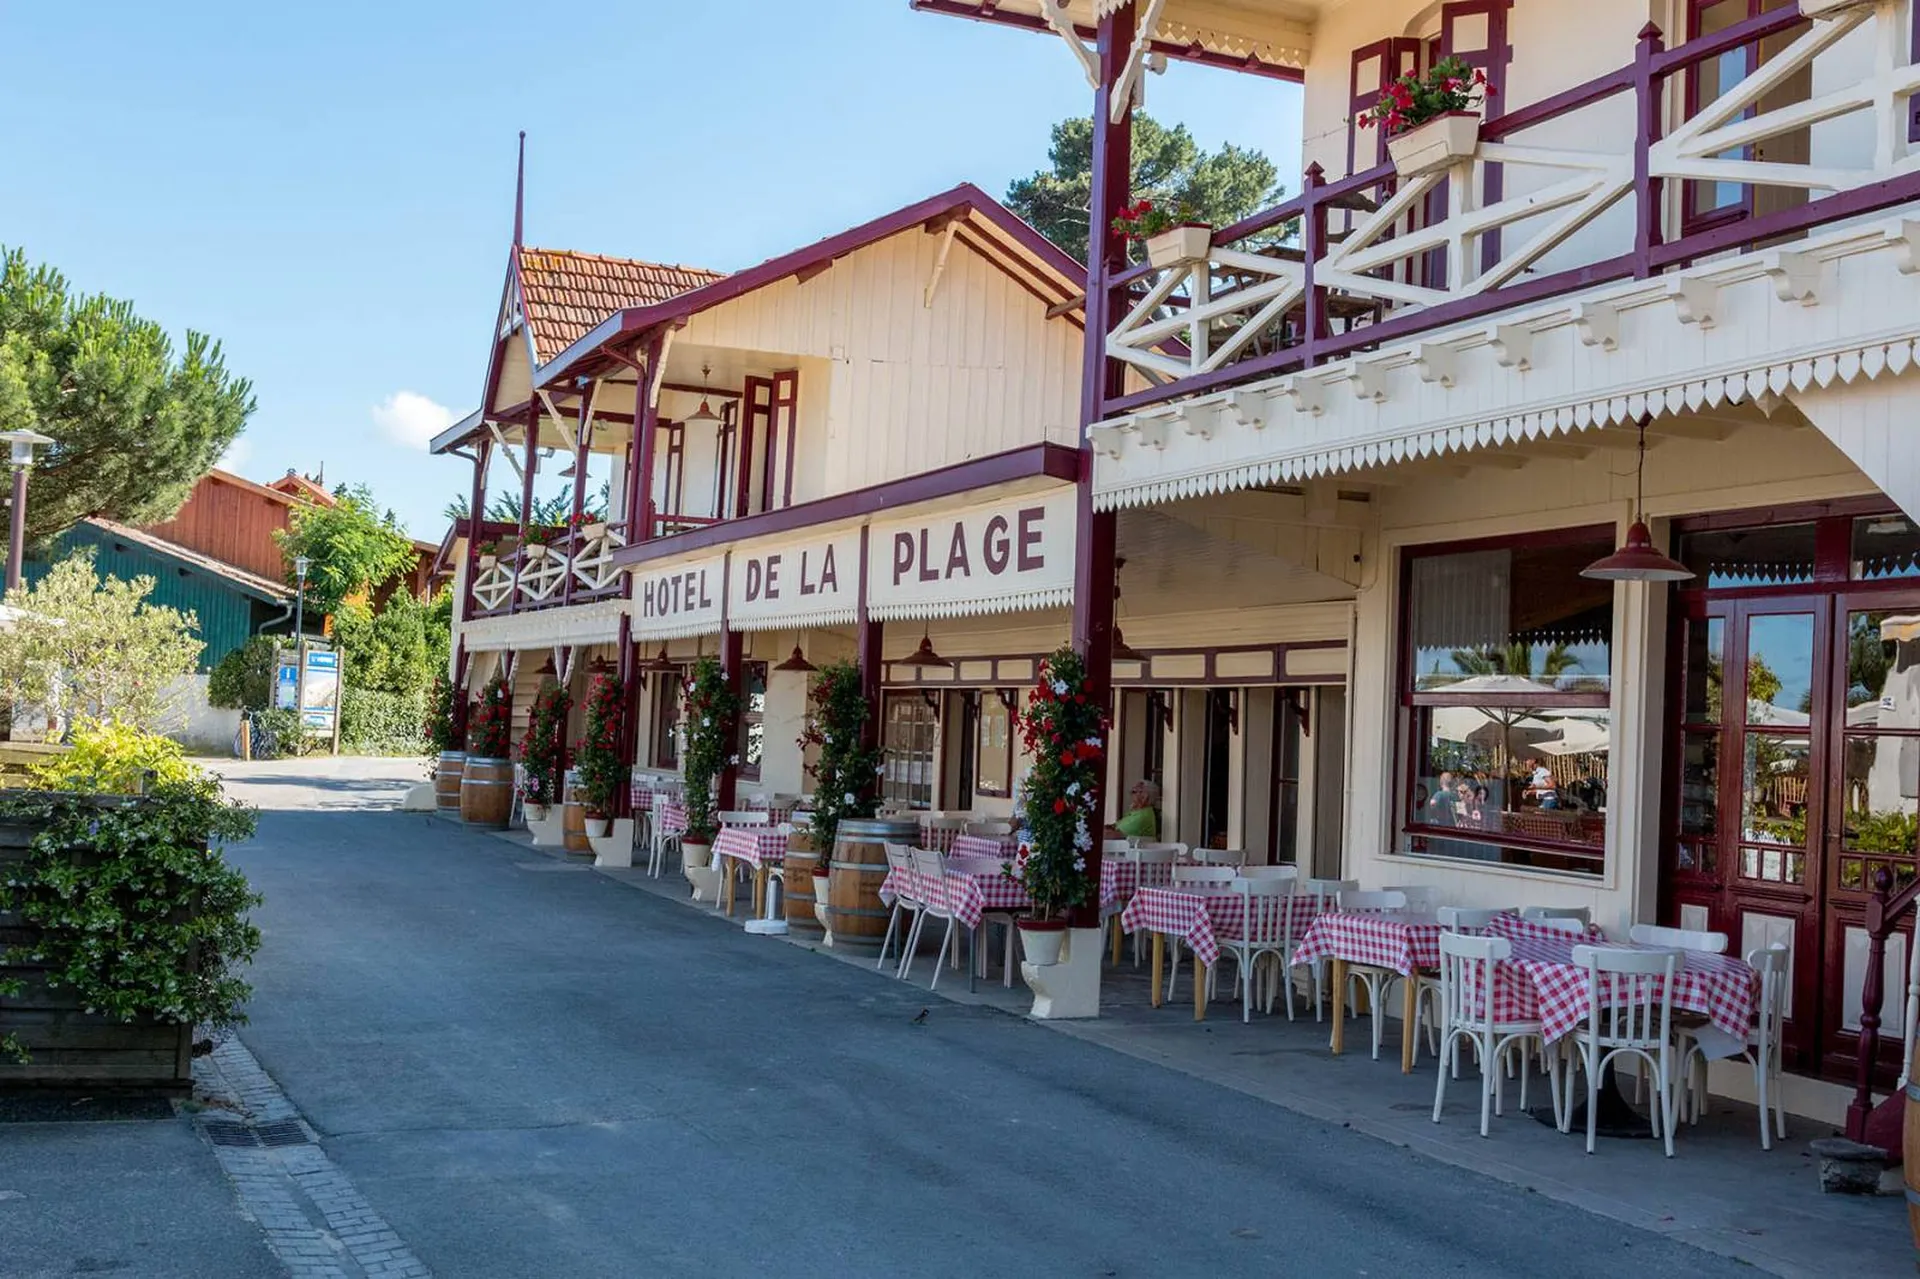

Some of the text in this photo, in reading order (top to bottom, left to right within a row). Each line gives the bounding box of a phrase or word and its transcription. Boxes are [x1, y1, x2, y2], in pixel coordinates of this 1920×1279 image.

[643, 506, 1046, 618] HOTEL DE LA PLAGE
